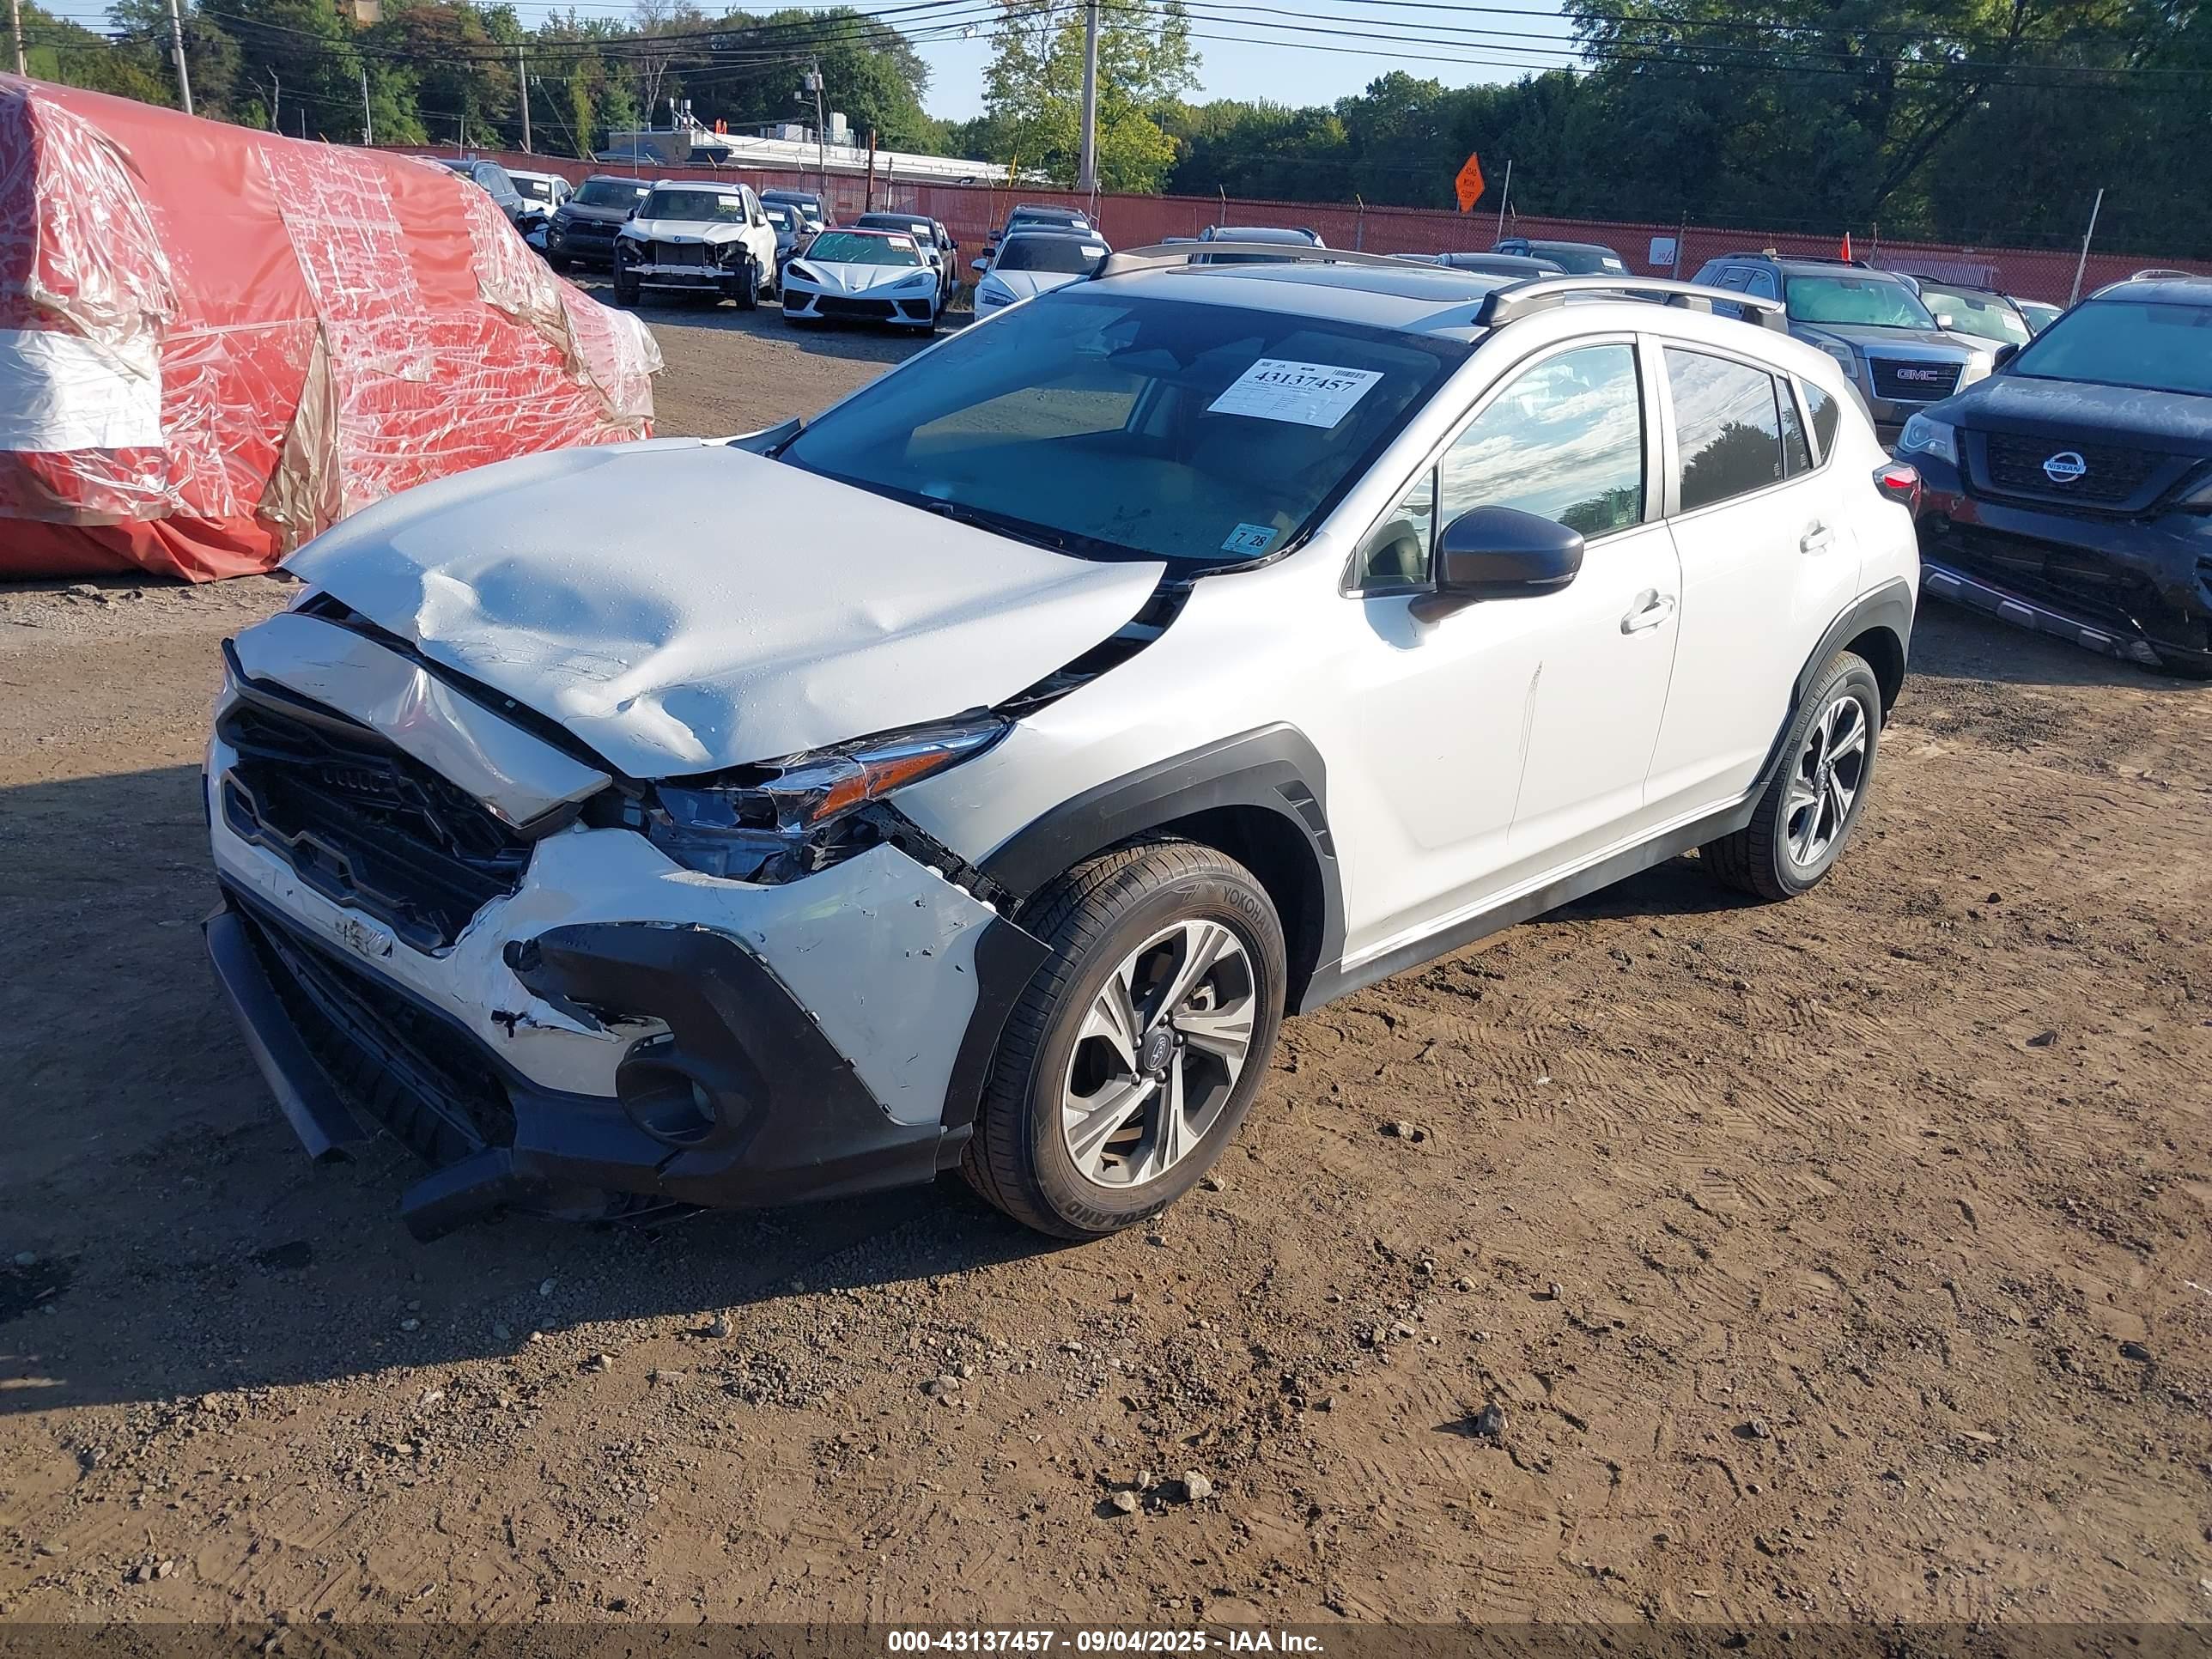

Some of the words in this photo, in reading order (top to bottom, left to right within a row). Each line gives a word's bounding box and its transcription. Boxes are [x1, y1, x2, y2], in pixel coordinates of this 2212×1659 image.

[1897, 368, 1938, 381] GMC
[1254, 370, 1357, 392] 43137457
[2047, 463, 2081, 472] NISSAN
[1235, 532, 1248, 544] 7
